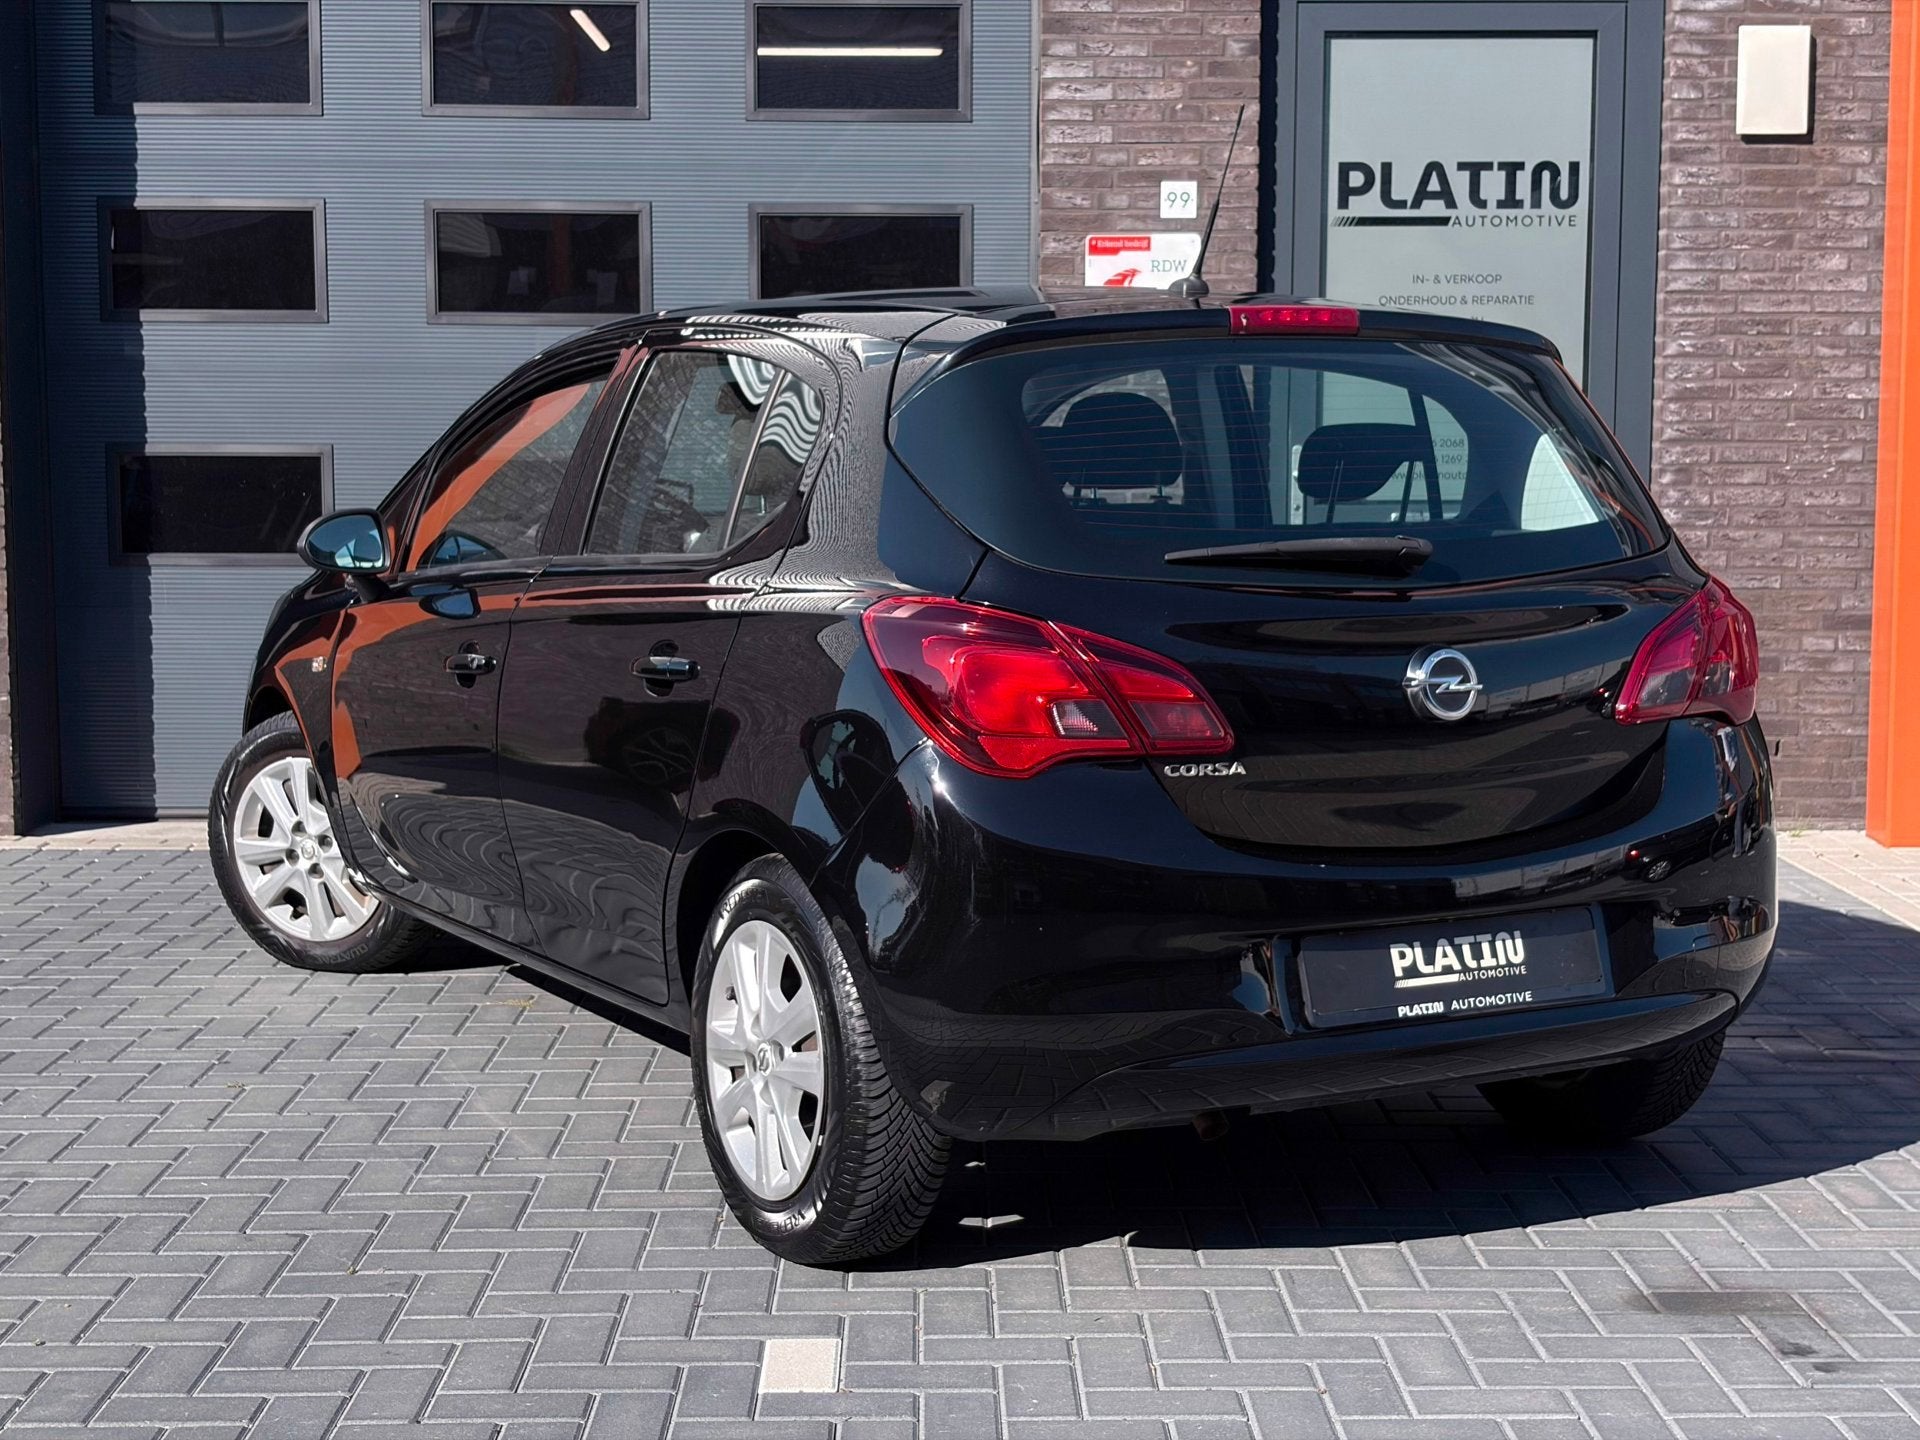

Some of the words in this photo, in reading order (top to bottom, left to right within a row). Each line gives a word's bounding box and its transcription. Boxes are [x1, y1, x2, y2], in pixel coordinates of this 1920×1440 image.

[1337, 160, 1580, 210] PLATIN
[1167, 191, 1190, 208] 99
[1451, 214, 1577, 228] AUTOMOTIVE
[1151, 259, 1187, 272] RDW
[1412, 274, 1430, 284] IN-
[1433, 274, 1441, 284] &
[1444, 273, 1503, 284] VERKOOP
[1378, 295, 1457, 306] ONDERHOUD
[1460, 295, 1468, 305] &
[1472, 294, 1535, 305] REPARATIE
[1164, 761, 1246, 777] CORSA
[1389, 929, 1525, 978] PLATIN
[1458, 965, 1527, 982] AUTOMOTIVE
[1397, 1001, 1444, 1018] PLATIN
[1451, 990, 1533, 1011] AUTOMOTIVE
